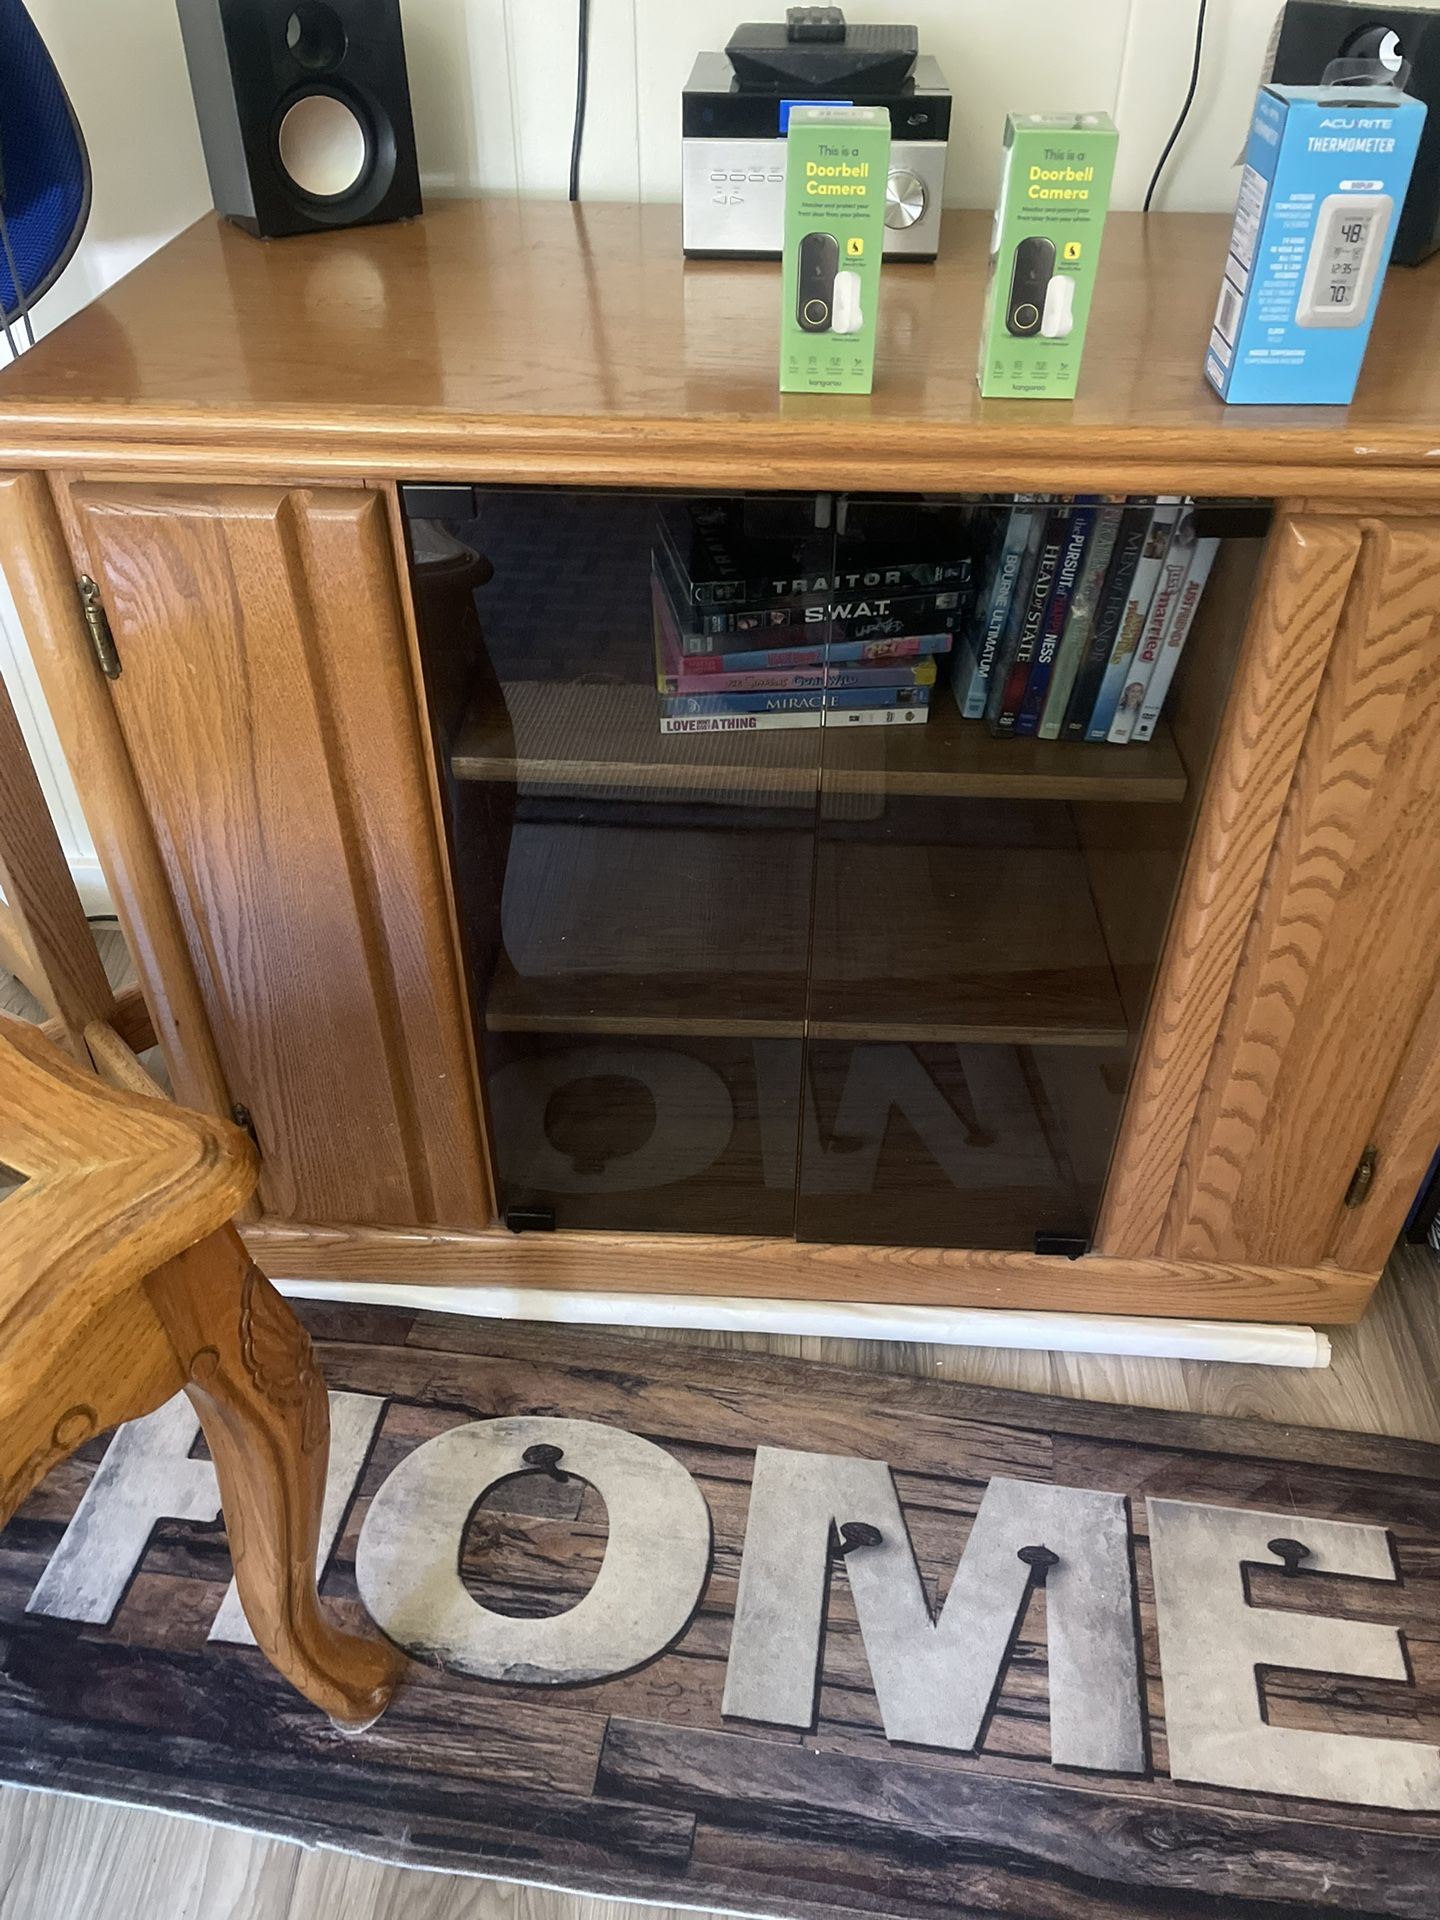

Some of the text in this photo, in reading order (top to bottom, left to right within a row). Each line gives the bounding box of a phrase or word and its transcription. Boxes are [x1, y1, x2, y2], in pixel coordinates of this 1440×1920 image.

[818, 144, 859, 157] This is a
[1308, 136, 1395, 152] THERMOMETER
[1044, 148, 1085, 161] This is a
[806, 161, 869, 178] Doorbell
[1029, 166, 1094, 181] Doorbell
[806, 180, 866, 196] Camera
[1028, 184, 1089, 200] Camera
[1341, 224, 1362, 243] 48
[1330, 285, 1346, 302] 70
[1060, 534, 1085, 587] PURSUIT
[1033, 544, 1060, 599] HEAD
[772, 571, 901, 594] TRAITOR
[804, 600, 891, 624] S.W.A.T.
[977, 554, 1018, 678] BOURNE ULTIMATUM
[1092, 588, 1123, 662] HONOR
[1016, 606, 1042, 663] STATE
[766, 695, 840, 710] MIRACE
[666, 719, 696, 732] LOVE
[711, 718, 719, 731] A
[719, 717, 757, 730] THING
